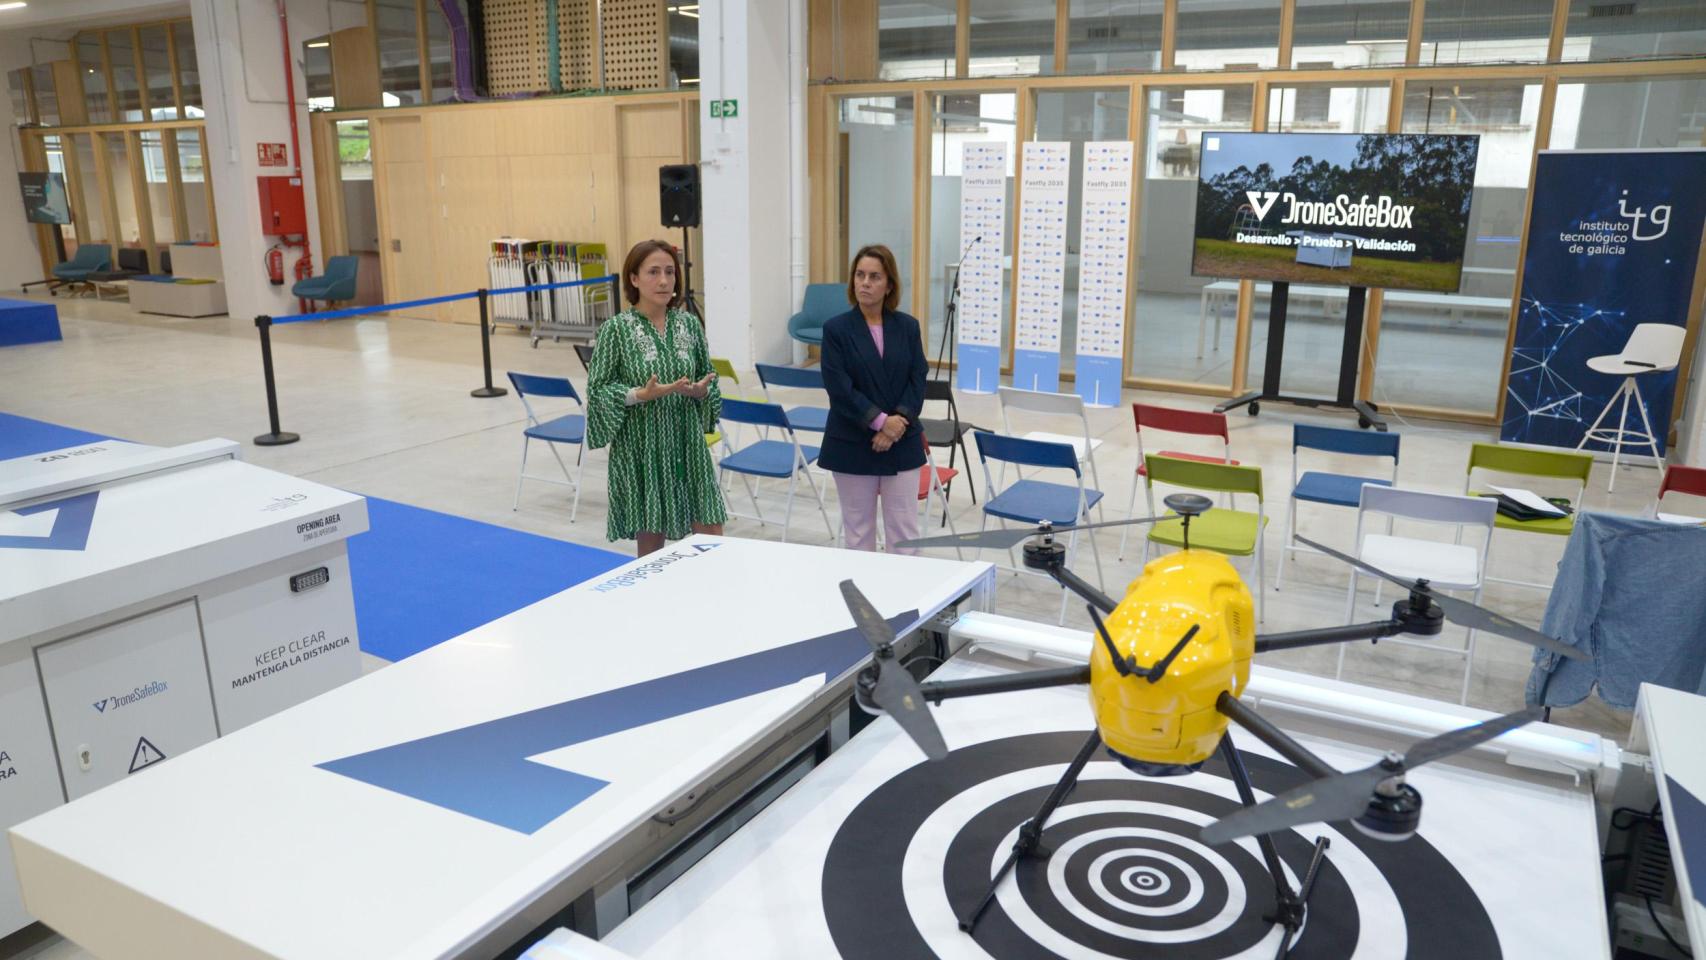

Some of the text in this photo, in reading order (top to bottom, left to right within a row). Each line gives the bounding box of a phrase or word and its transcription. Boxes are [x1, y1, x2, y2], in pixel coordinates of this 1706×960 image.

[1281, 192, 1415, 228] DroneSafeBox
[1618, 189, 1672, 241] itg
[1560, 232, 1628, 244] tecnológico
[1580, 221, 1630, 231] instituto
[1236, 232, 1292, 246] Desarrollo
[1303, 236, 1343, 248] Prueba
[1355, 238, 1416, 252] Validación
[1568, 244, 1626, 256] de galicia
[297, 513, 341, 534] OPENING AREA
[255, 630, 326, 667] KEEP CLEAR
[232, 636, 350, 689] MANTENGA LA DISTANCIA
[110, 681, 168, 710] DroneSafeBox
